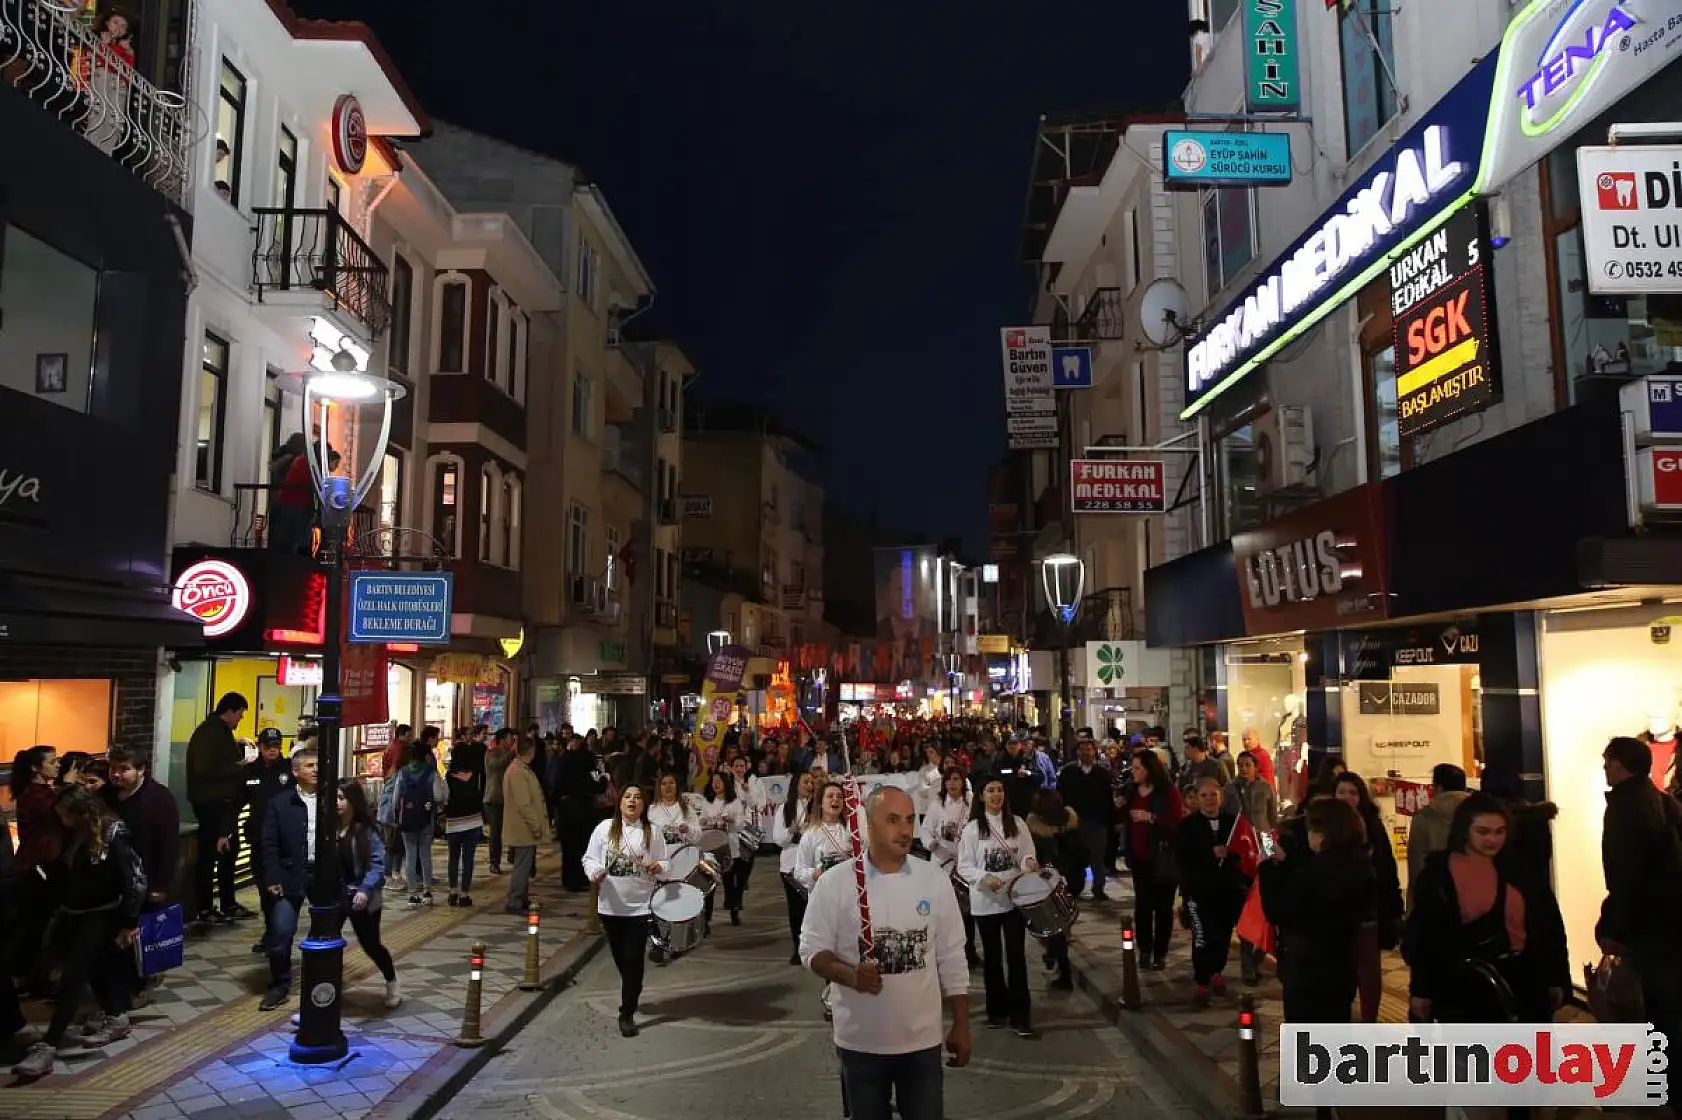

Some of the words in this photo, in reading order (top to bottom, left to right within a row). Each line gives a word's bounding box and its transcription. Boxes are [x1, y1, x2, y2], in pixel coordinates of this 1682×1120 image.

[1634, 27, 1665, 56] Hasta
[1517, 7, 1636, 110] TENA
[1210, 149, 1236, 159] EYÜP
[1238, 149, 1268, 161] ŞAHİN
[1210, 162, 1250, 173] SÜRÜCÜ
[1252, 164, 1286, 175] KURSU
[1613, 224, 1647, 249] Dt.
[1654, 224, 1681, 249] Ul
[1625, 261, 1664, 278] 0532
[1189, 275, 1281, 392] FURKAN
[1407, 289, 1473, 366] SGK
[1009, 348, 1047, 361] Bartın
[1010, 360, 1048, 374] Güven
[1401, 364, 1484, 419] BAŞLAMIŞTIR
[1079, 464, 1155, 480] FURKAN
[1083, 500, 1110, 509] 228
[1245, 529, 1344, 610] LOTUS
[182, 582, 232, 605] Öncü
[366, 583, 393, 595] BARTIN
[394, 582, 435, 596] BELEDİYESİ
[357, 598, 375, 611] ÖZEL
[377, 600, 397, 611] HALK
[398, 599, 443, 613] OTOBÜSLERİ
[362, 617, 403, 630] BEKLEME
[404, 615, 437, 631] DURAĞI
[1392, 692, 1436, 705] CAZADOR
